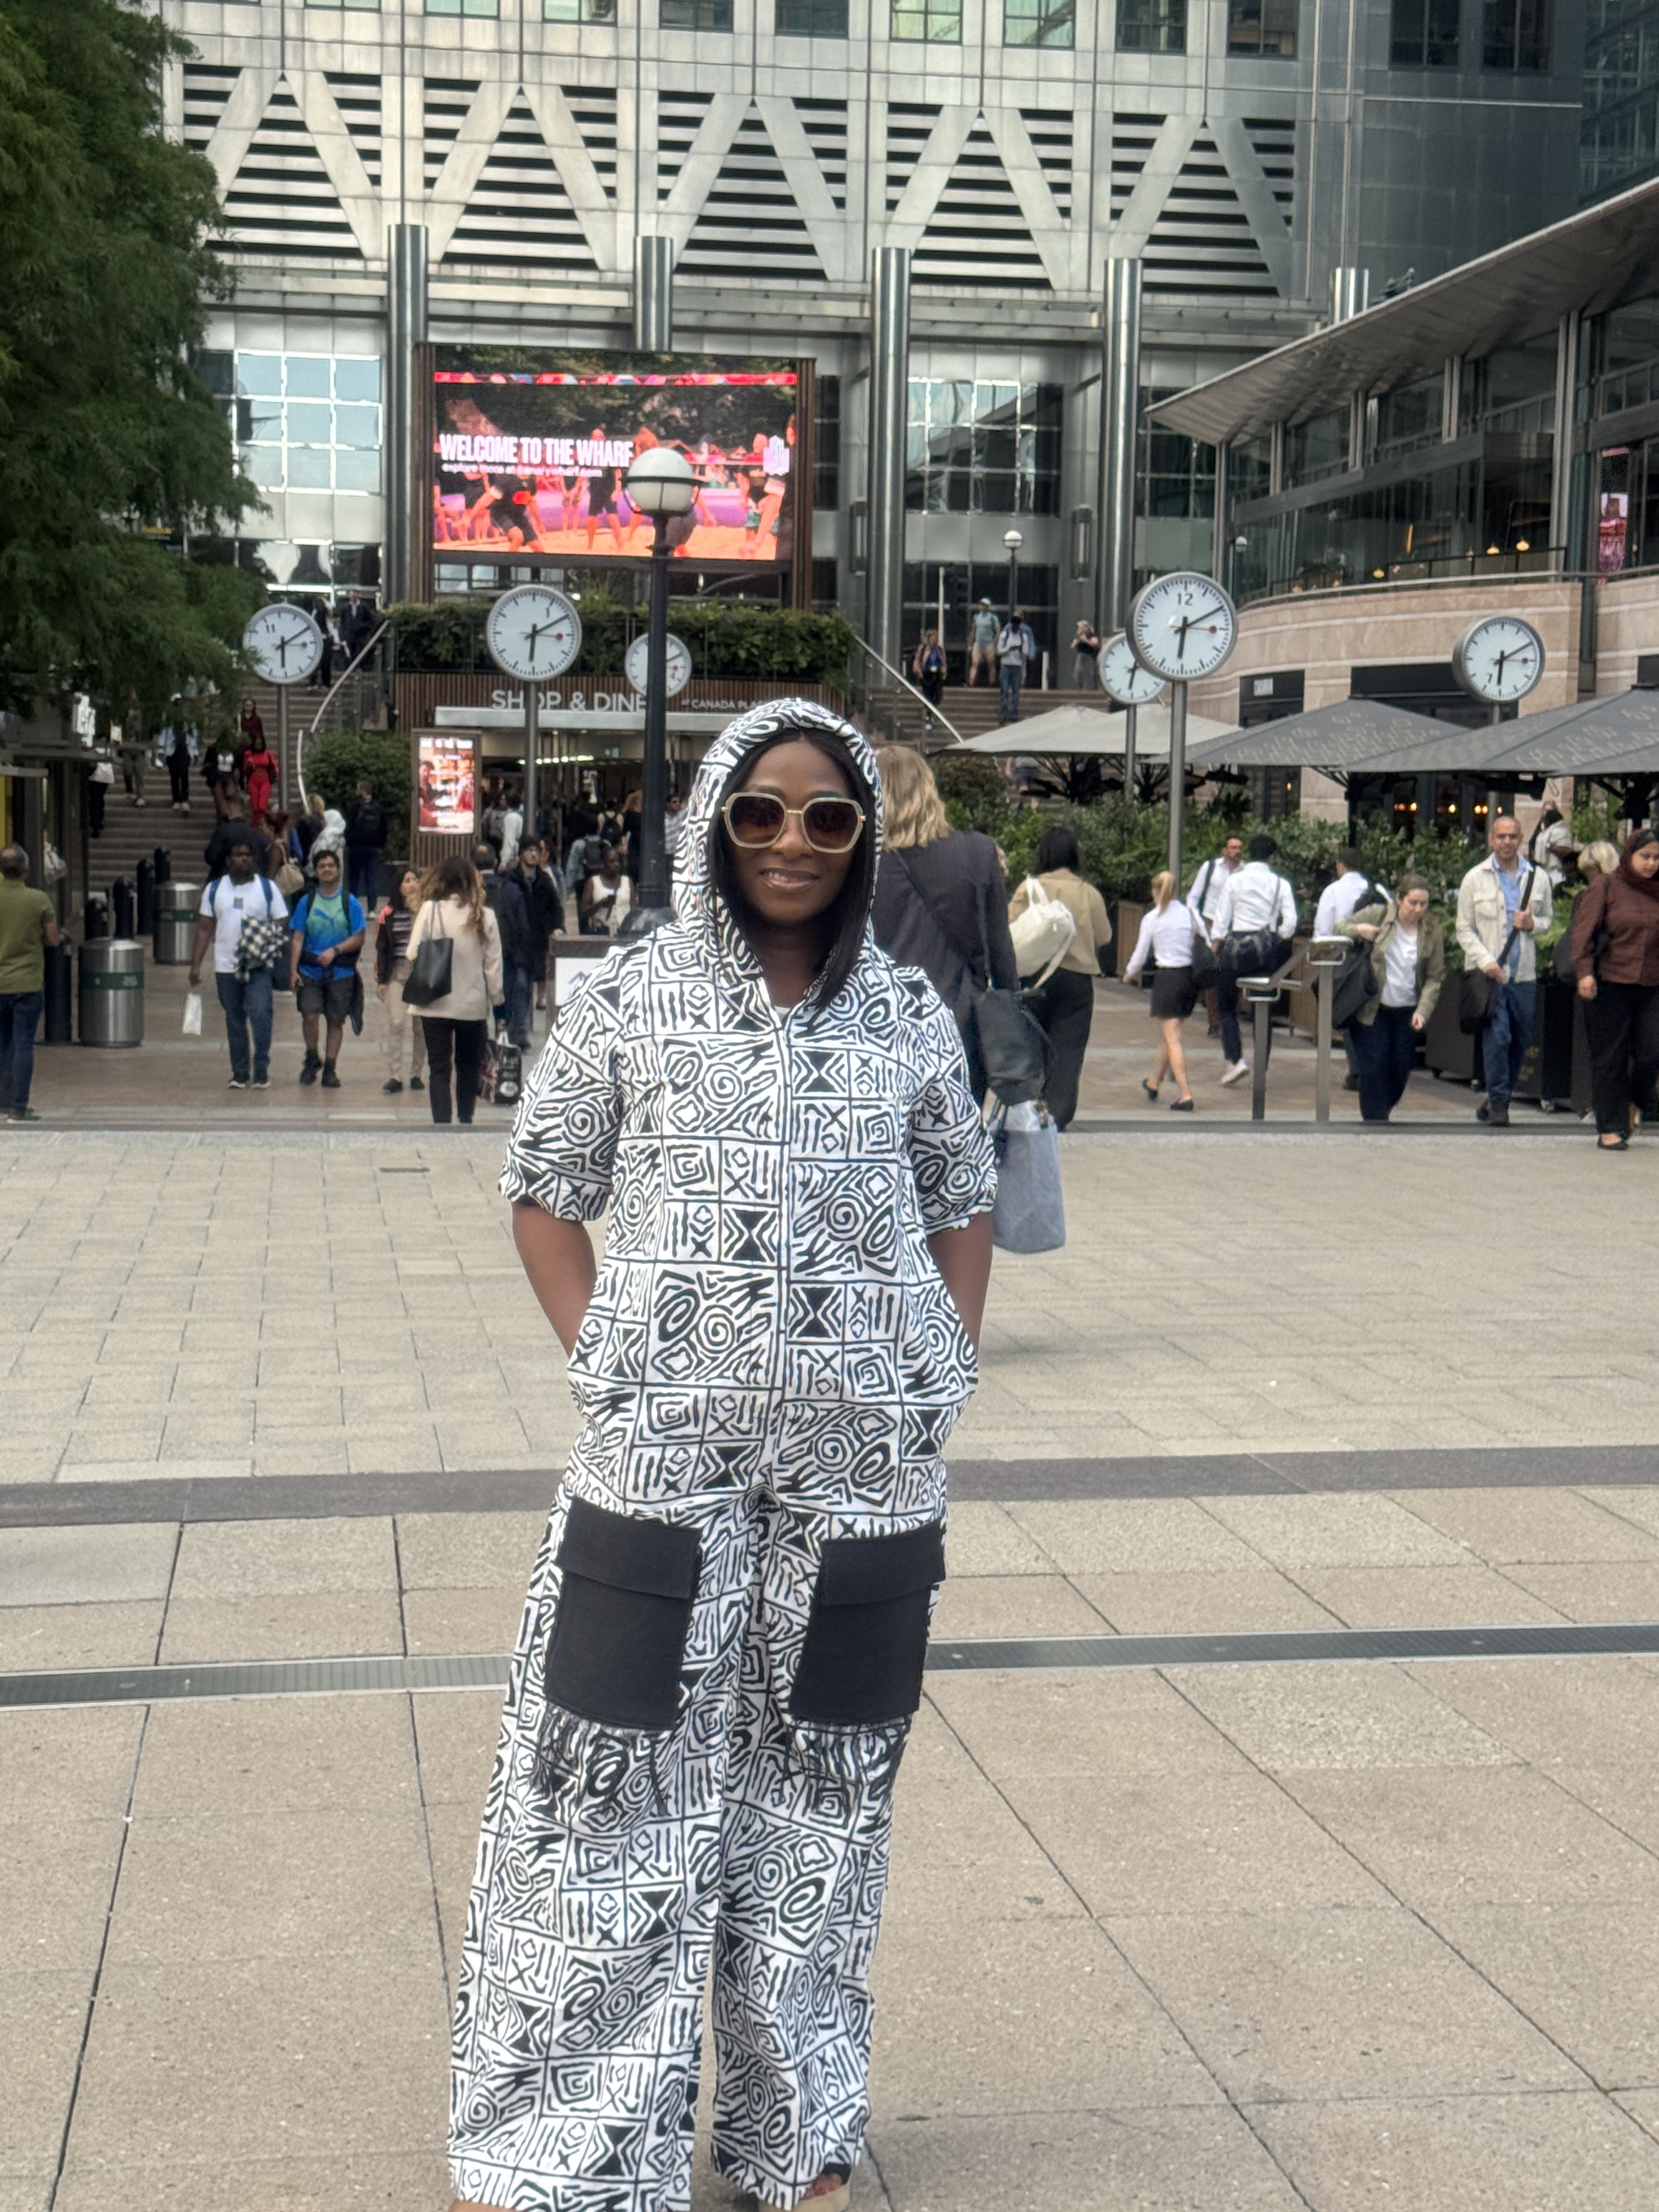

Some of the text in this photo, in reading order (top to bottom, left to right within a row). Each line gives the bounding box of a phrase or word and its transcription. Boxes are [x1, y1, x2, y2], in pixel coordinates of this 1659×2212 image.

[439, 434, 634, 467] WELCOME TO THE WHARF
[1177, 593, 1194, 606] 12
[545, 607, 550, 618] 1
[266, 623, 275, 634] 11
[1487, 673, 1493, 684] 7
[570, 690, 586, 711] &
[594, 692, 647, 713] DINE
[691, 699, 736, 709] CANADA
